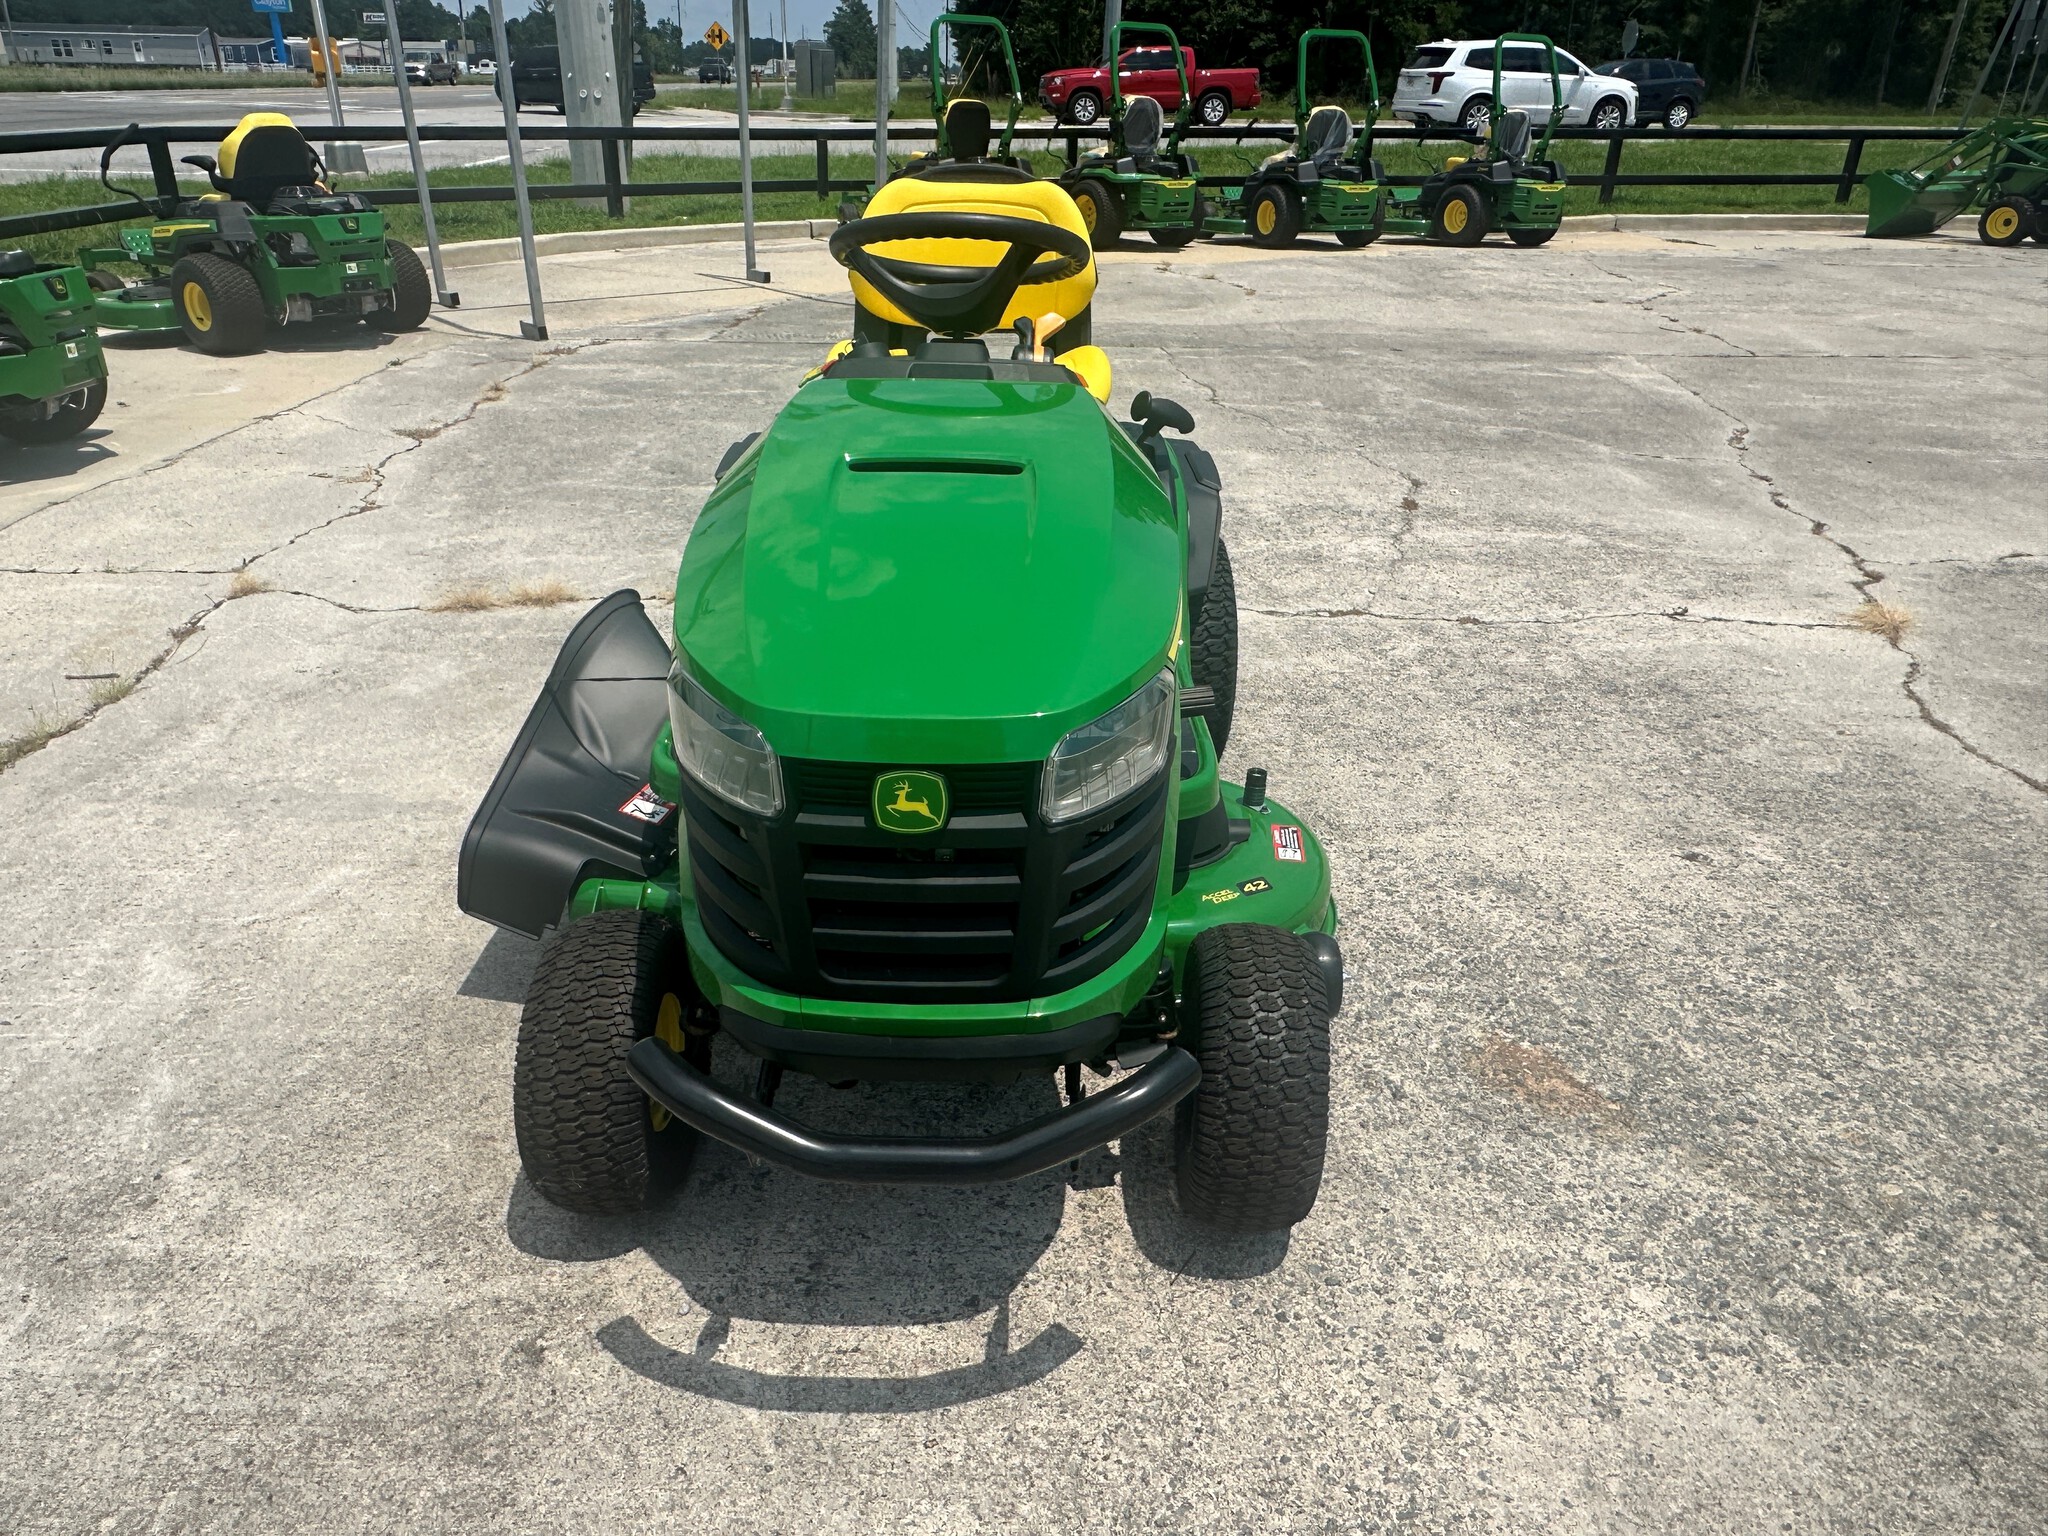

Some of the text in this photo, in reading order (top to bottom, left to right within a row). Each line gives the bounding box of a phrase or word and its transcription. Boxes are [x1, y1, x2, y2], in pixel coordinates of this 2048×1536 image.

[1243, 880, 1269, 892] 42
[1202, 889, 1234, 902] ACCEL
[1212, 892, 1241, 904] DEEP
